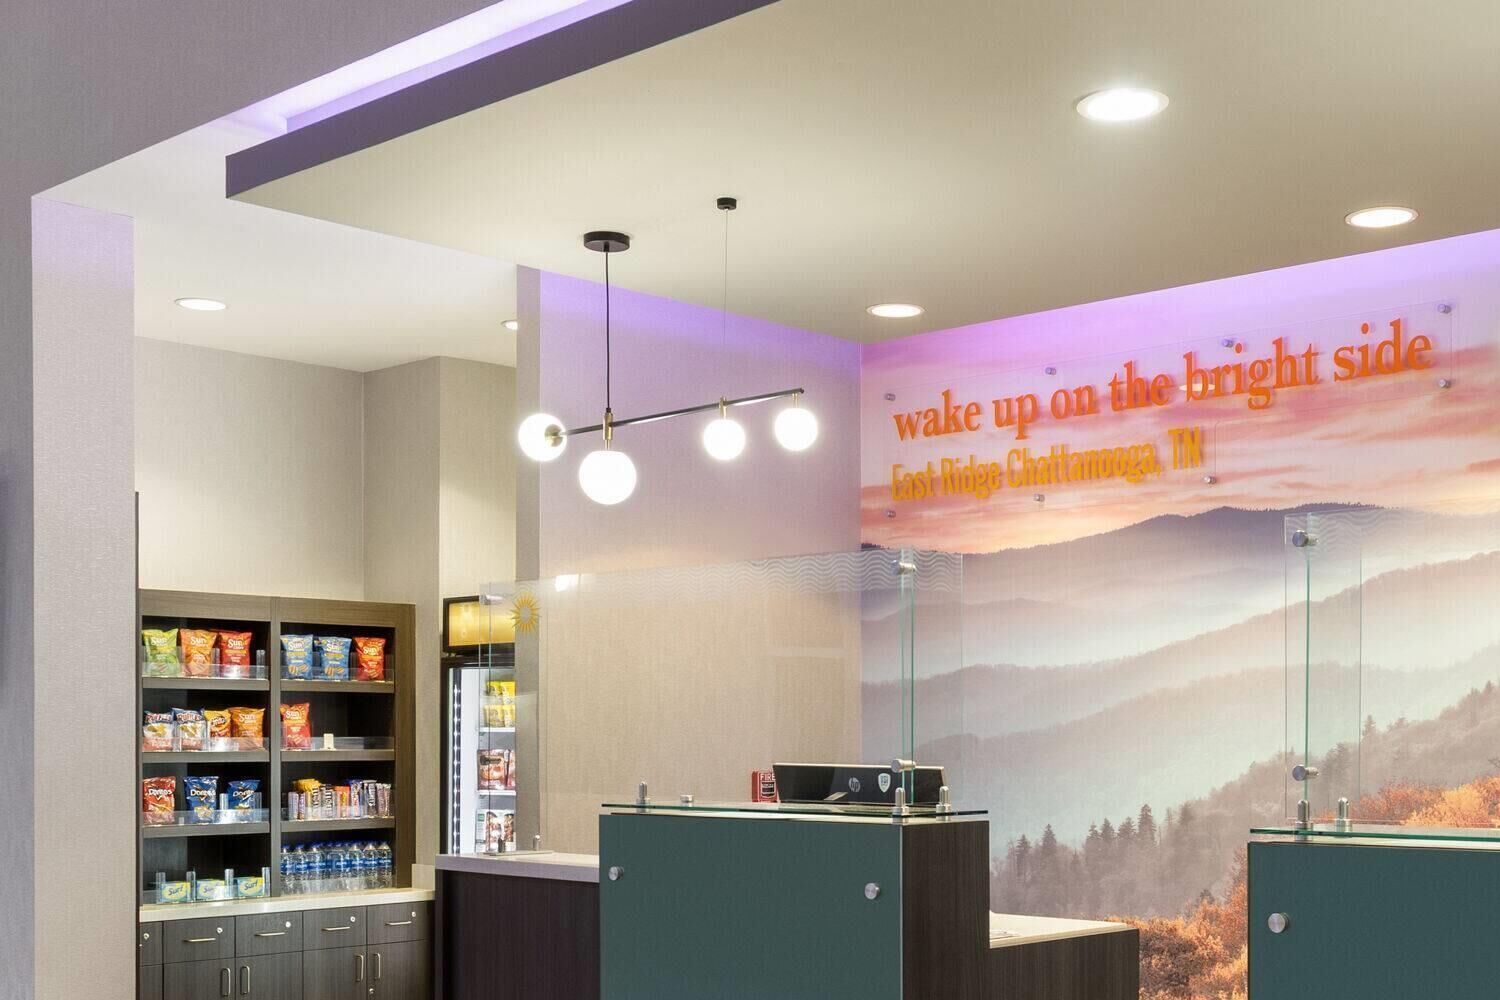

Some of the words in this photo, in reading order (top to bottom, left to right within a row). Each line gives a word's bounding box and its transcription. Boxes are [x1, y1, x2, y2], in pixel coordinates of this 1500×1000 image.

[893, 390, 981, 441] wake
[992, 393, 1037, 440] up
[1051, 383, 1100, 420] on
[1109, 361, 1171, 411] the
[1183, 336, 1321, 410] bright
[1333, 318, 1432, 383] side
[892, 461, 935, 501] East
[941, 455, 1000, 499] Ridge
[1007, 443, 1161, 489] Chattanooga,
[1167, 427, 1201, 470] TN
[227, 638, 244, 648] Sun
